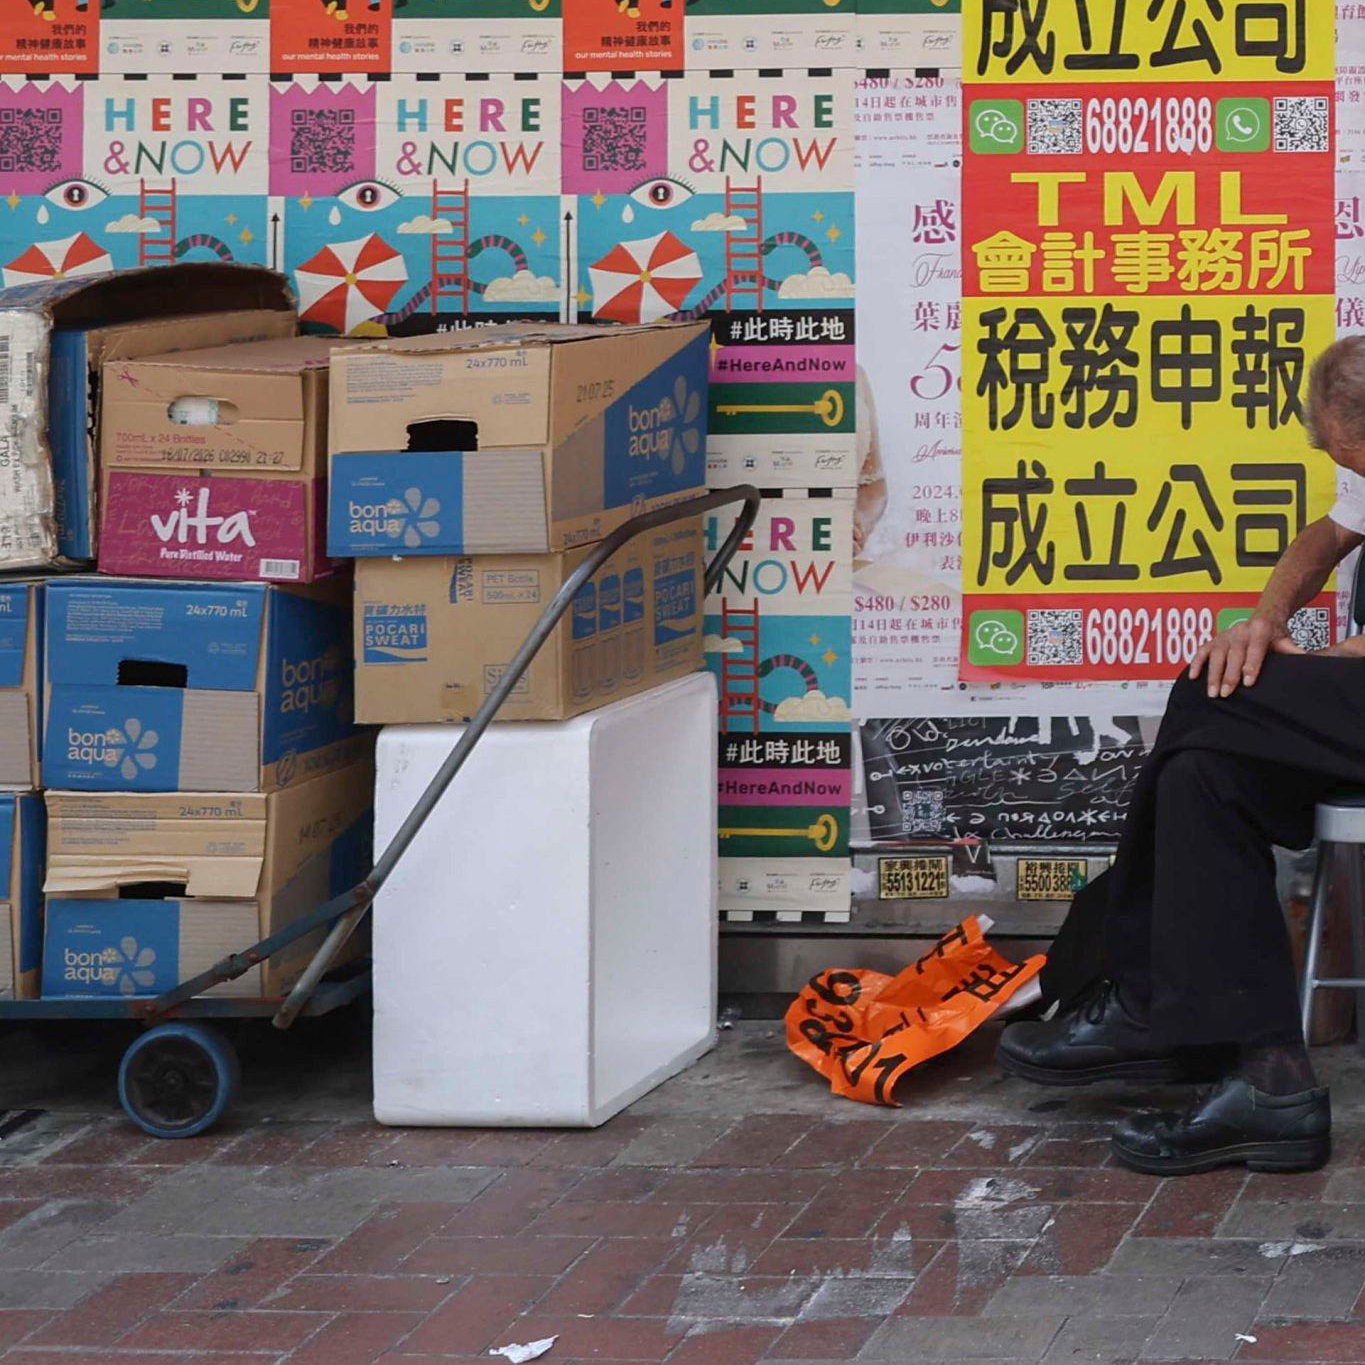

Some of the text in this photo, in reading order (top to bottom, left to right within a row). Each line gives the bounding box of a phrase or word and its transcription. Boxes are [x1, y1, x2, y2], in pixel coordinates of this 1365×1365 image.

[689, 95, 833, 130] HERE
[1086, 97, 1213, 155] 68821888
[151, 487, 256, 547] vita
[366, 624, 425, 635] POCARI
[366, 635, 420, 647] SWEAT
